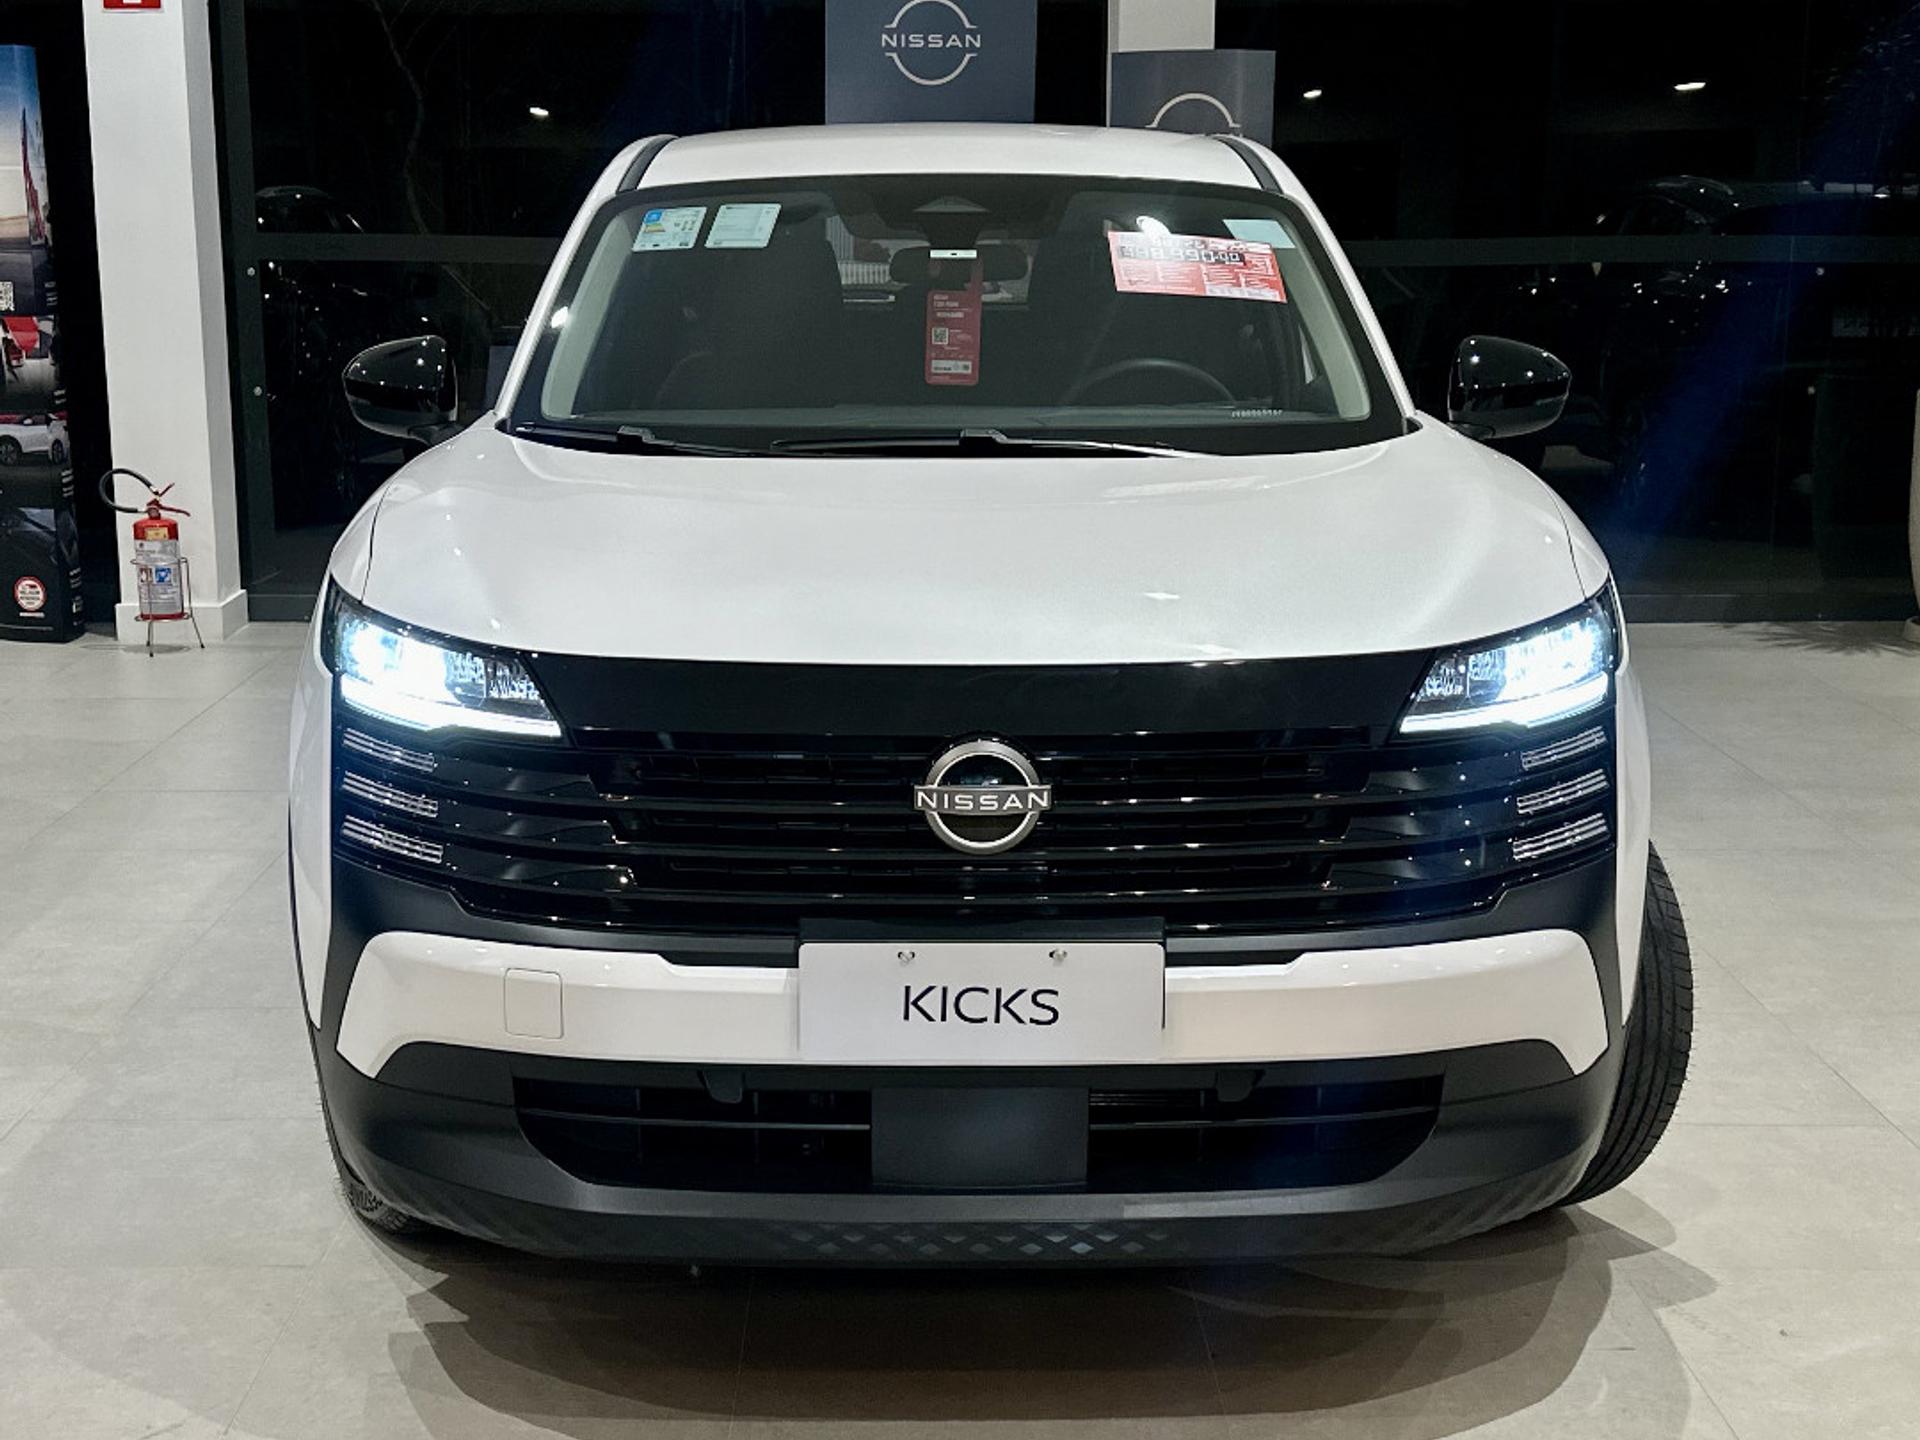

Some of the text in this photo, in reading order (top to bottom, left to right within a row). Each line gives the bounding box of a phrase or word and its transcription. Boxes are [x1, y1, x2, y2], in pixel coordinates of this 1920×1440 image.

[881, 33, 981, 48] NISSAN
[917, 791, 1049, 811] NISSAN
[903, 985, 1059, 1026] KICKS
